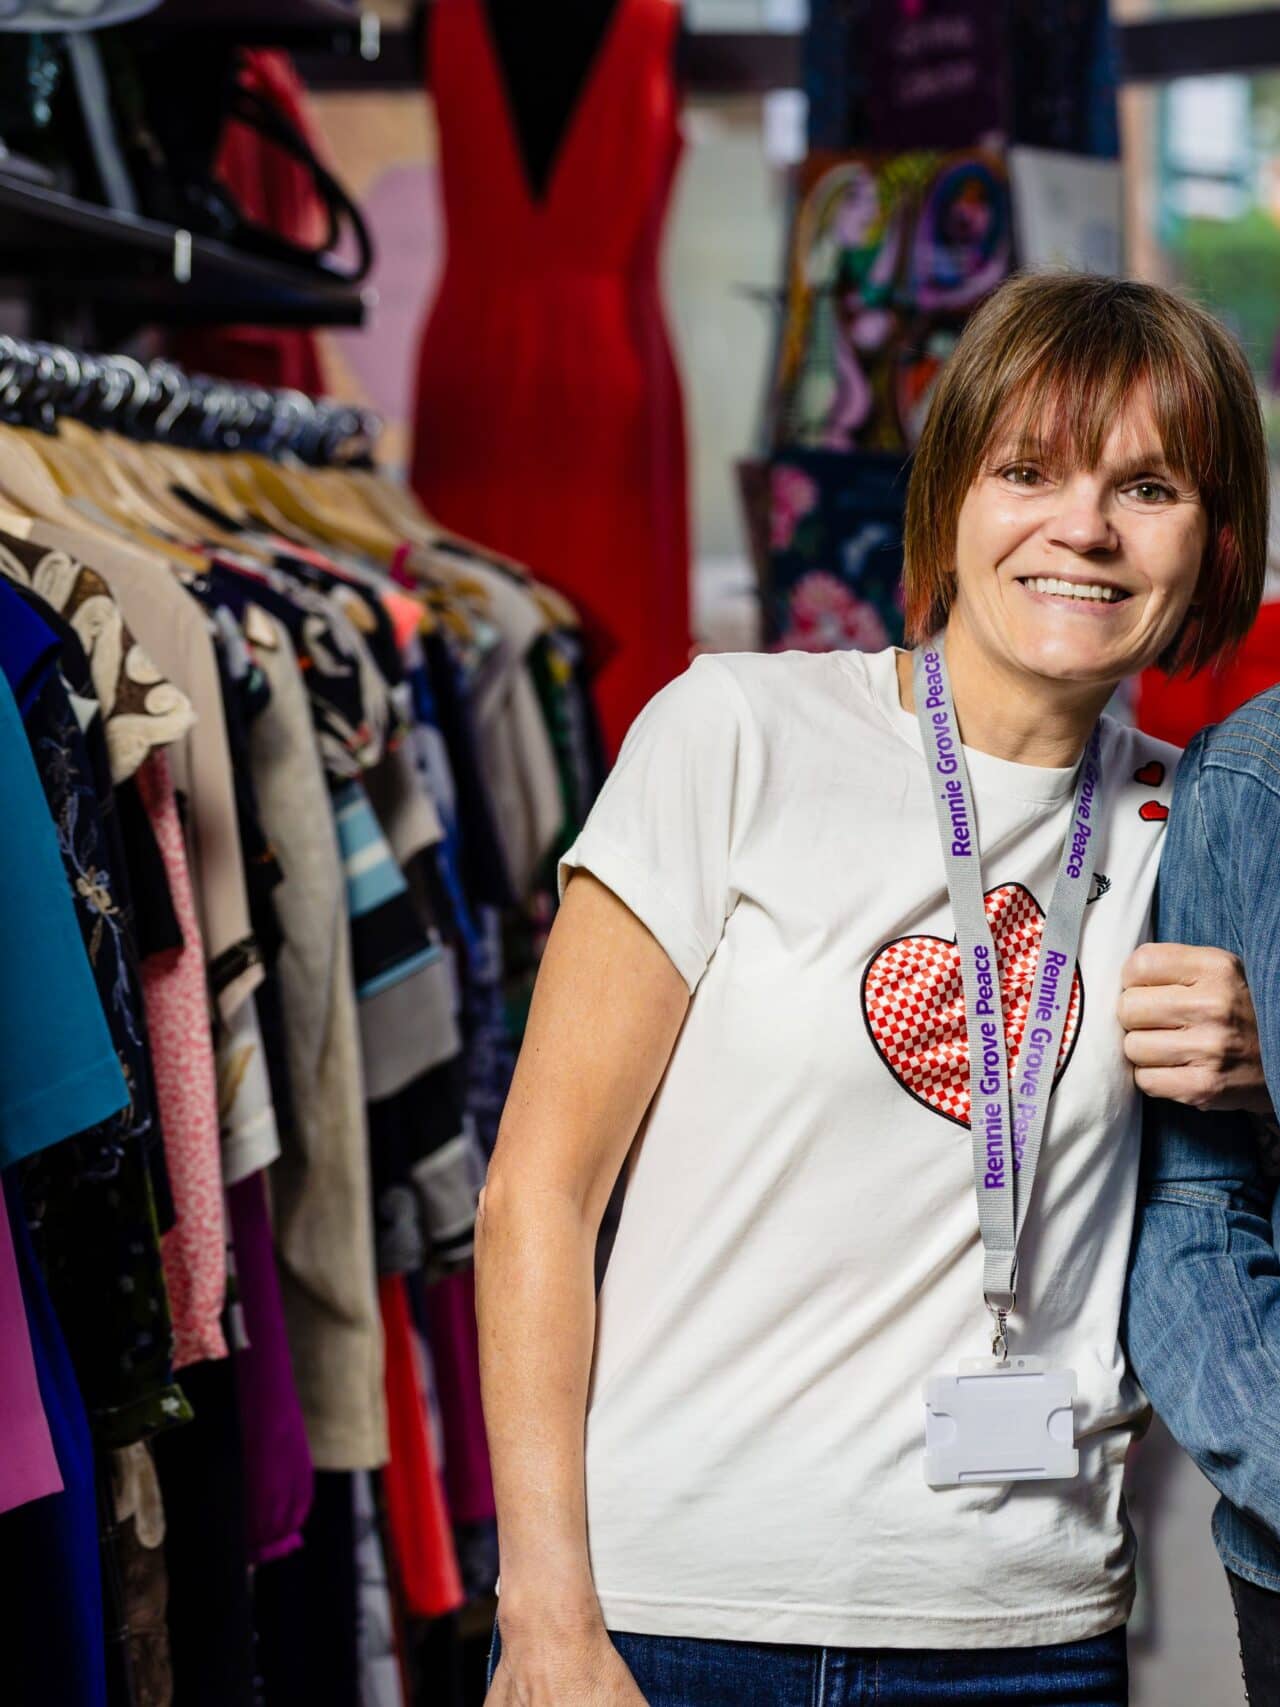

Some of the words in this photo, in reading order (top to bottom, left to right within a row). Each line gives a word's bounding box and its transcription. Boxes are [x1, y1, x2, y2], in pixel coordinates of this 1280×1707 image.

[924, 651, 945, 709] Peace
[931, 712, 958, 774] Grove
[941, 780, 972, 857] Rennie
[1078, 764, 1099, 820] Grove
[1066, 818, 1092, 879] Peace
[975, 945, 995, 1017] Peace
[1036, 950, 1067, 1022] Rennie
[979, 1023, 1000, 1095] Grove
[1020, 1027, 1052, 1097] Grove
[977, 1103, 1005, 1190] Rennie
